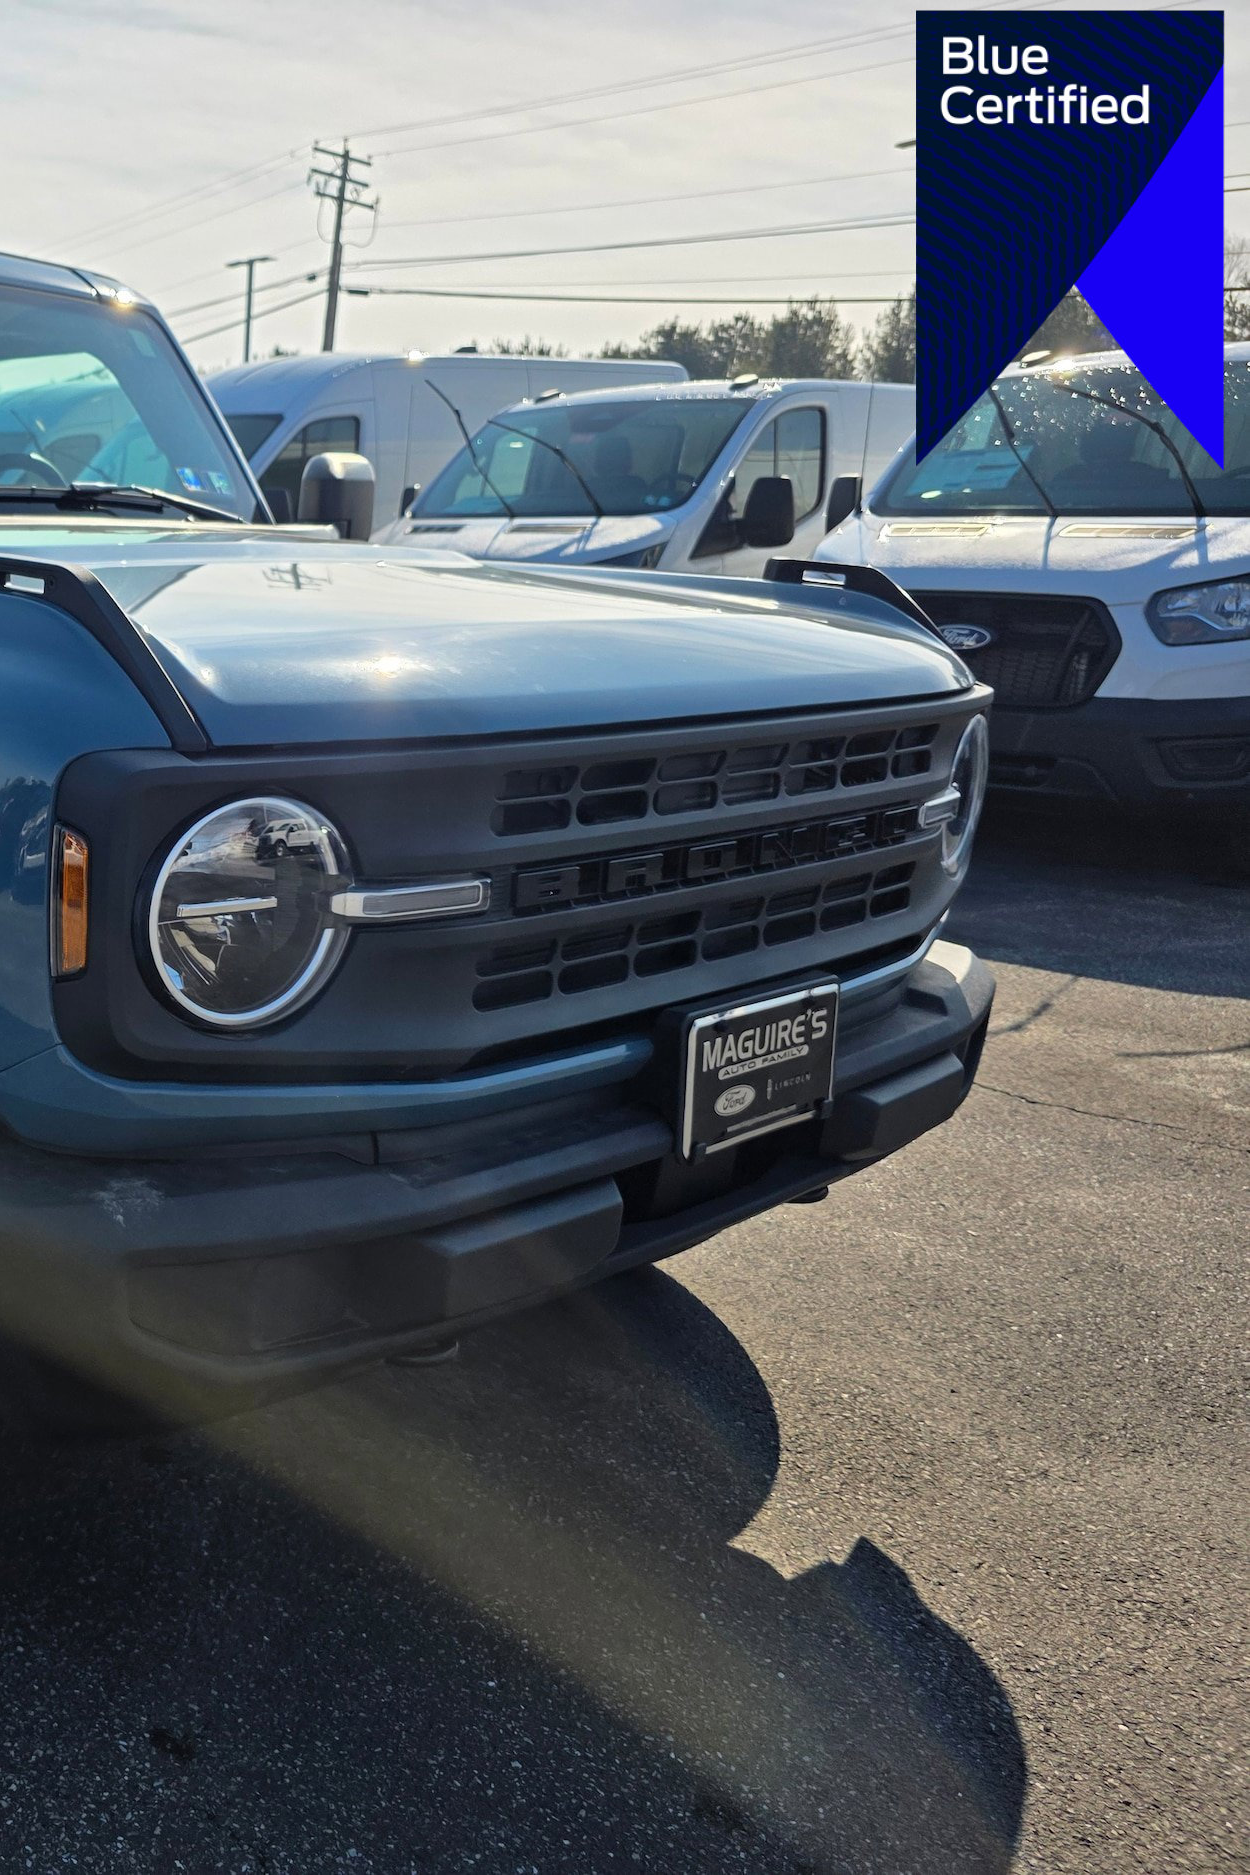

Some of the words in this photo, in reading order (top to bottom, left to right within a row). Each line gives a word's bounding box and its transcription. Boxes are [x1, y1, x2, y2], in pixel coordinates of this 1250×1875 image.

[943, 628, 980, 646] Ford
[516, 805, 919, 909] BRONCO
[702, 1008, 828, 1072] MAGUIRE'S
[722, 1060, 756, 1078] AUTO
[761, 1047, 805, 1066] FAMILY
